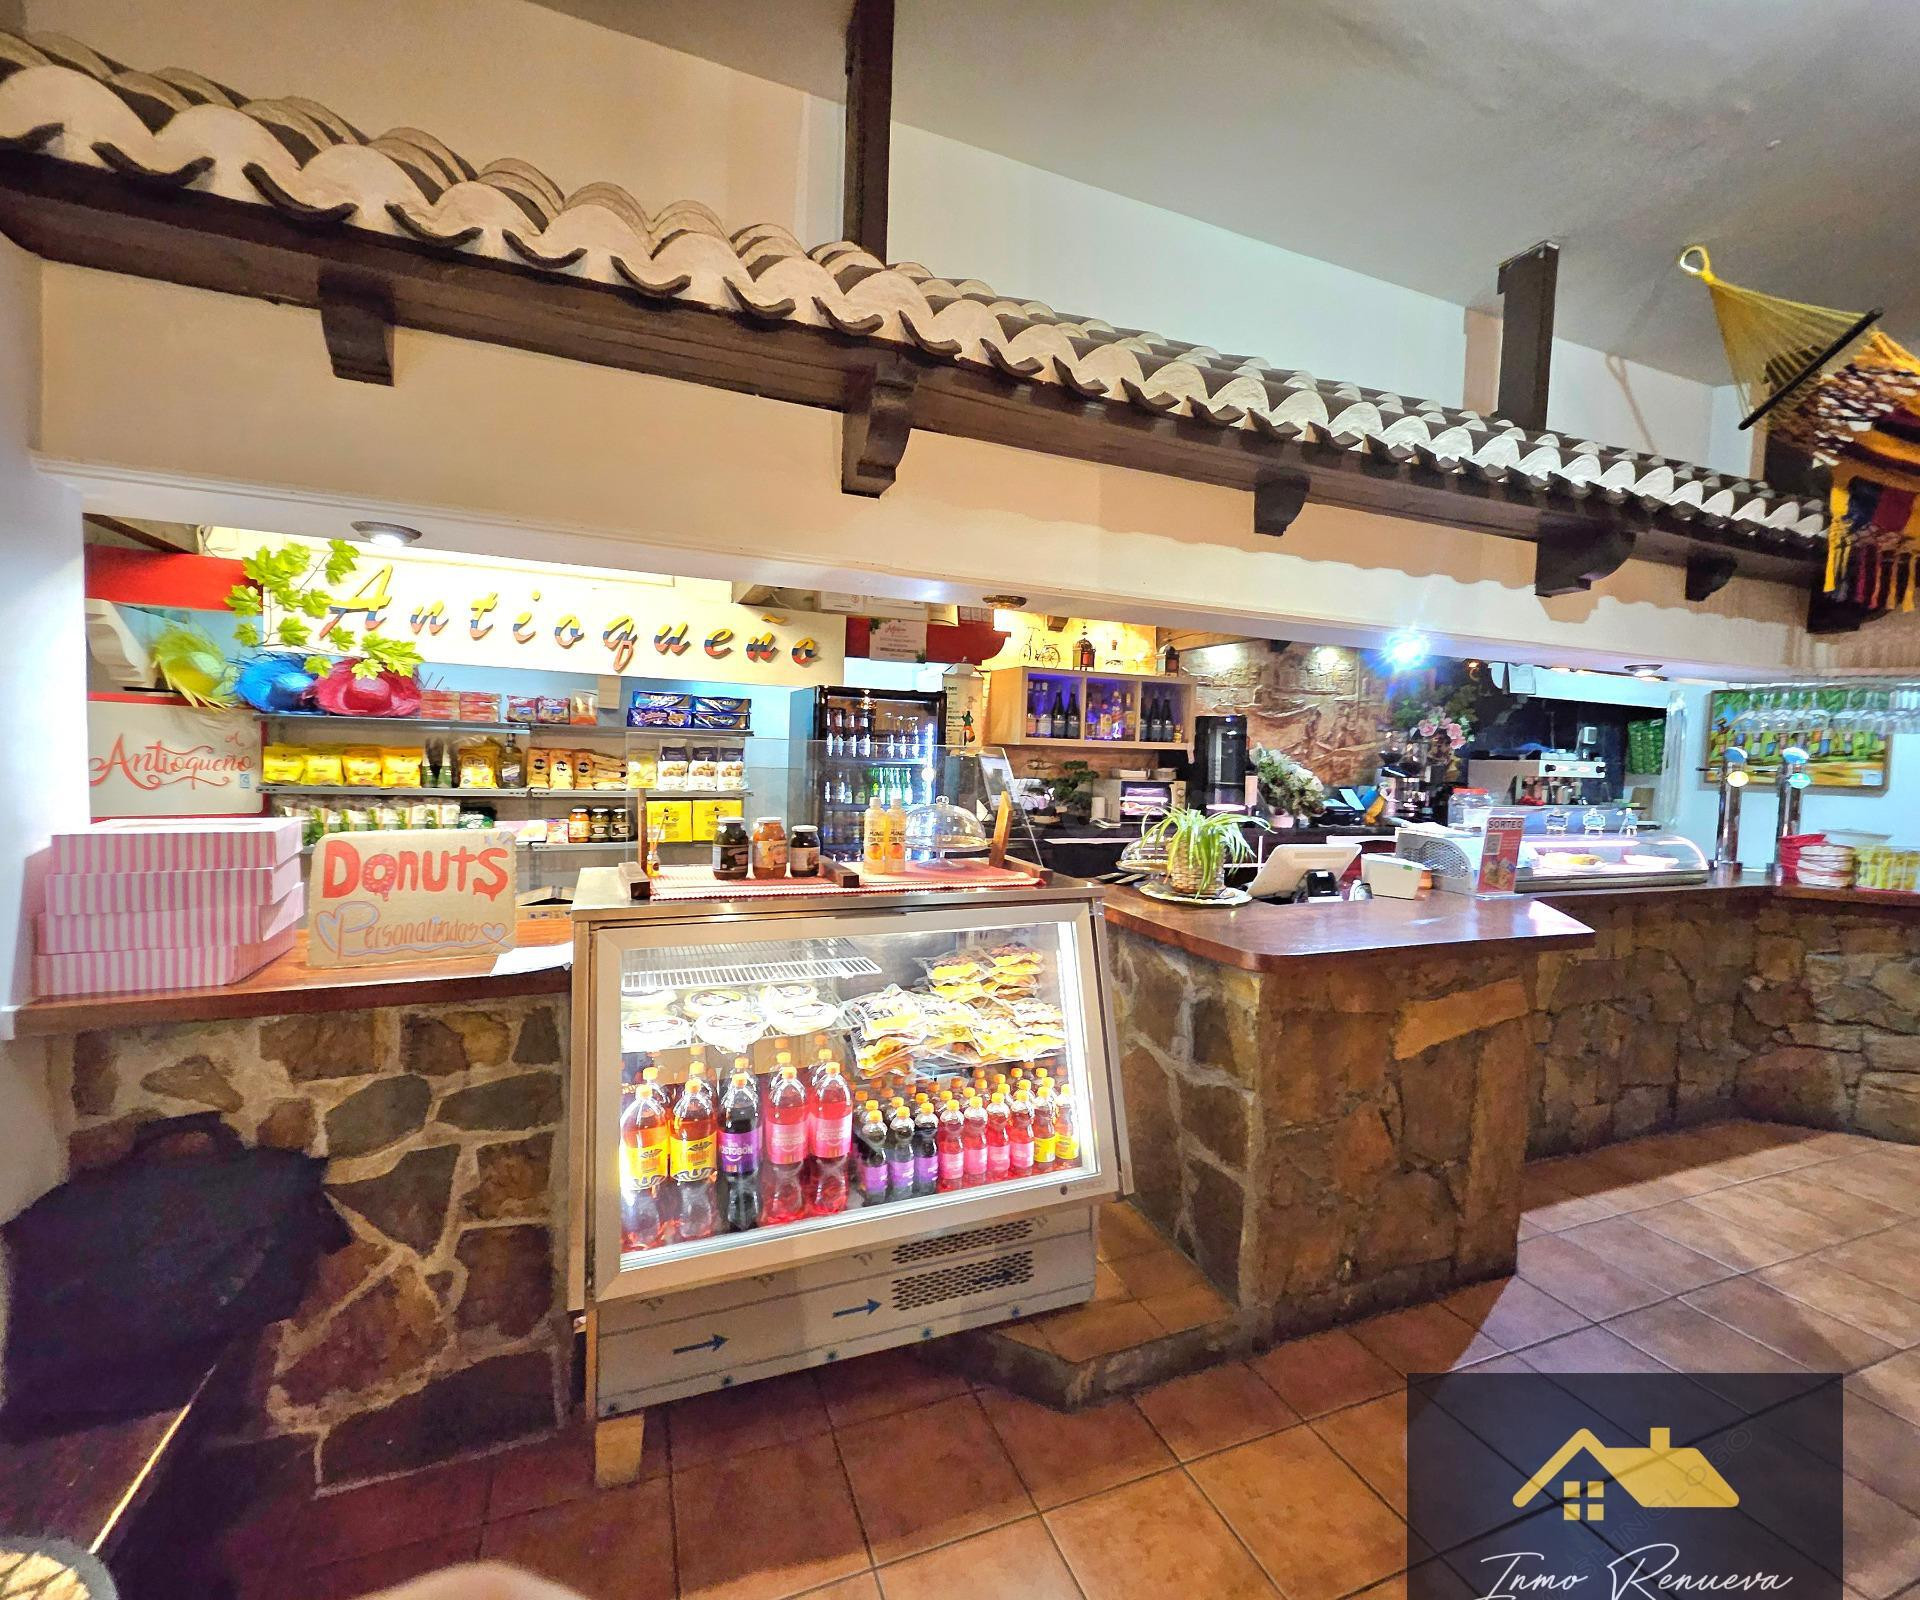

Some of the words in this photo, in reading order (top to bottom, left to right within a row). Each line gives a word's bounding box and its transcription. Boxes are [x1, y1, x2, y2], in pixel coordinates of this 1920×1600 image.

[319, 563, 820, 674] Antioqueño
[88, 733, 255, 790] Antioqueño
[1488, 820, 1522, 829] SORTEO
